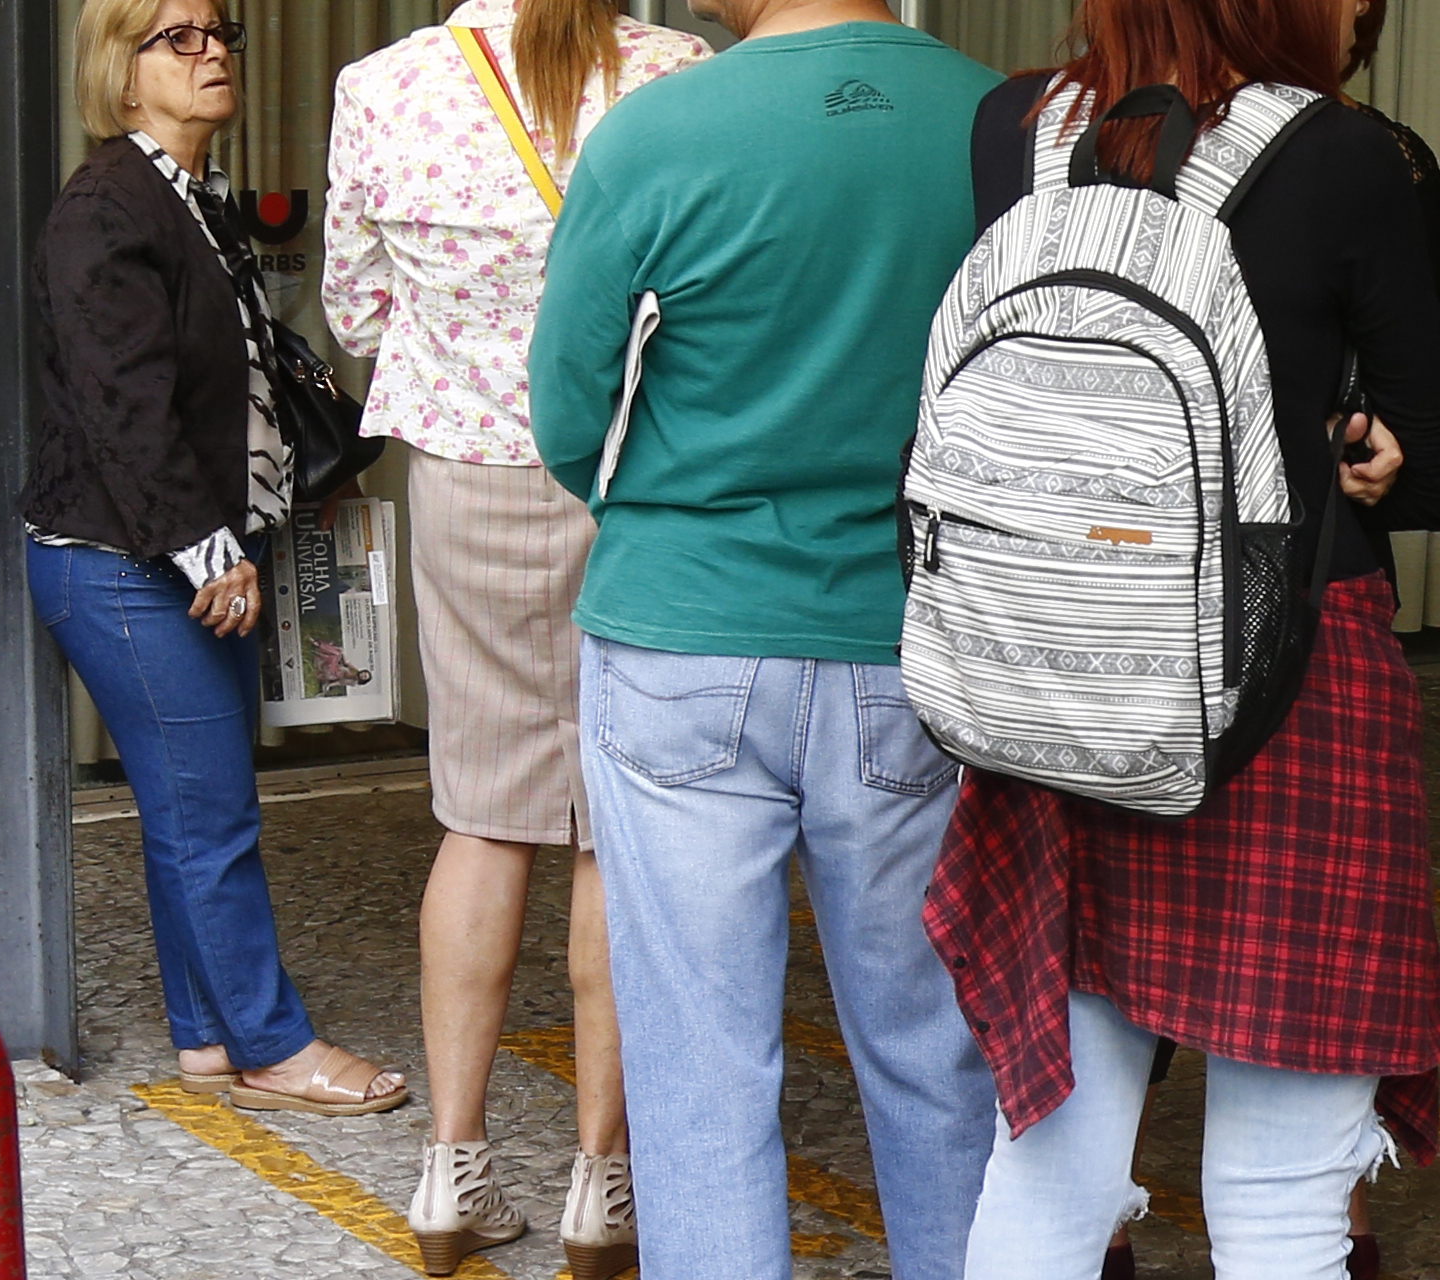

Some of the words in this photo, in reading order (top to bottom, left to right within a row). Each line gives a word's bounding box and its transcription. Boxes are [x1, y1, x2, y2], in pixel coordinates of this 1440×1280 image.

[250, 253, 306, 271] RBS
[295, 512, 316, 614] UNIVERSAL
[312, 531, 332, 592] FOLHA
